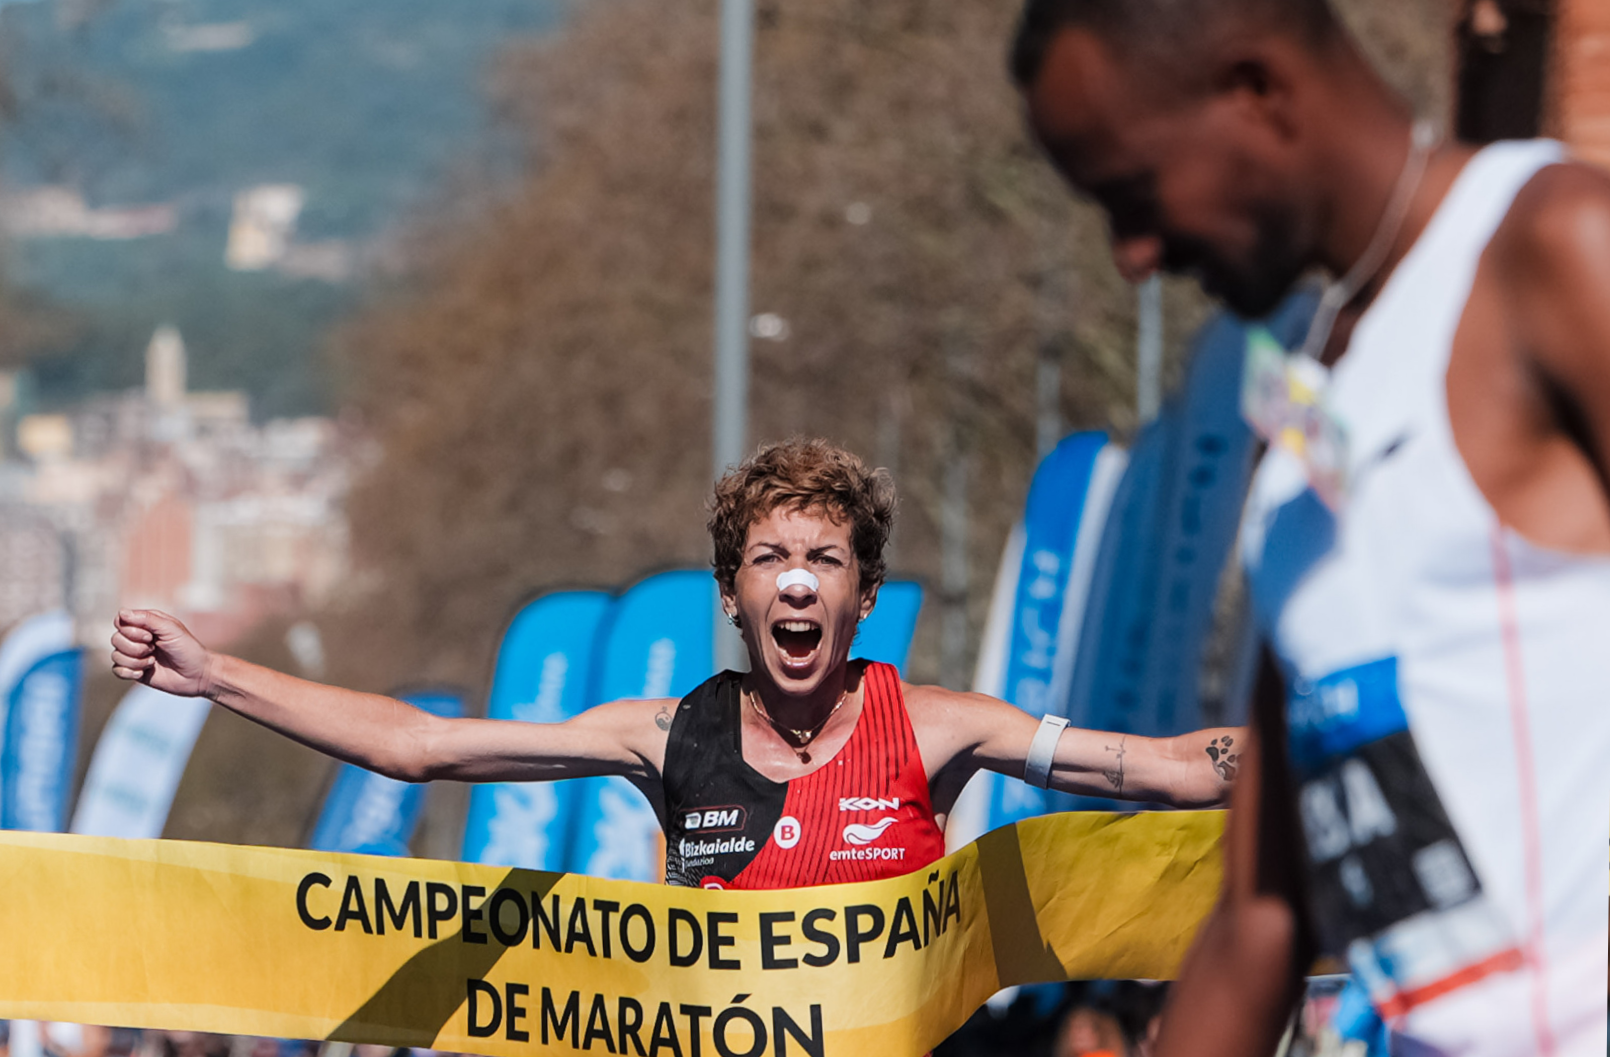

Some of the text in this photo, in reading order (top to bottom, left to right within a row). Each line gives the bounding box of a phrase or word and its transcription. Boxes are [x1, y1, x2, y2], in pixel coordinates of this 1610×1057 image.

[838, 796, 900, 811] KON
[702, 809, 739, 828] BM
[780, 825, 795, 841] B
[685, 836, 755, 858] Bizkaialde
[829, 847, 906, 860] emteSPORT
[296, 869, 961, 971] CAMPEONATO DE ESPAÑA
[466, 978, 530, 1043] DE
